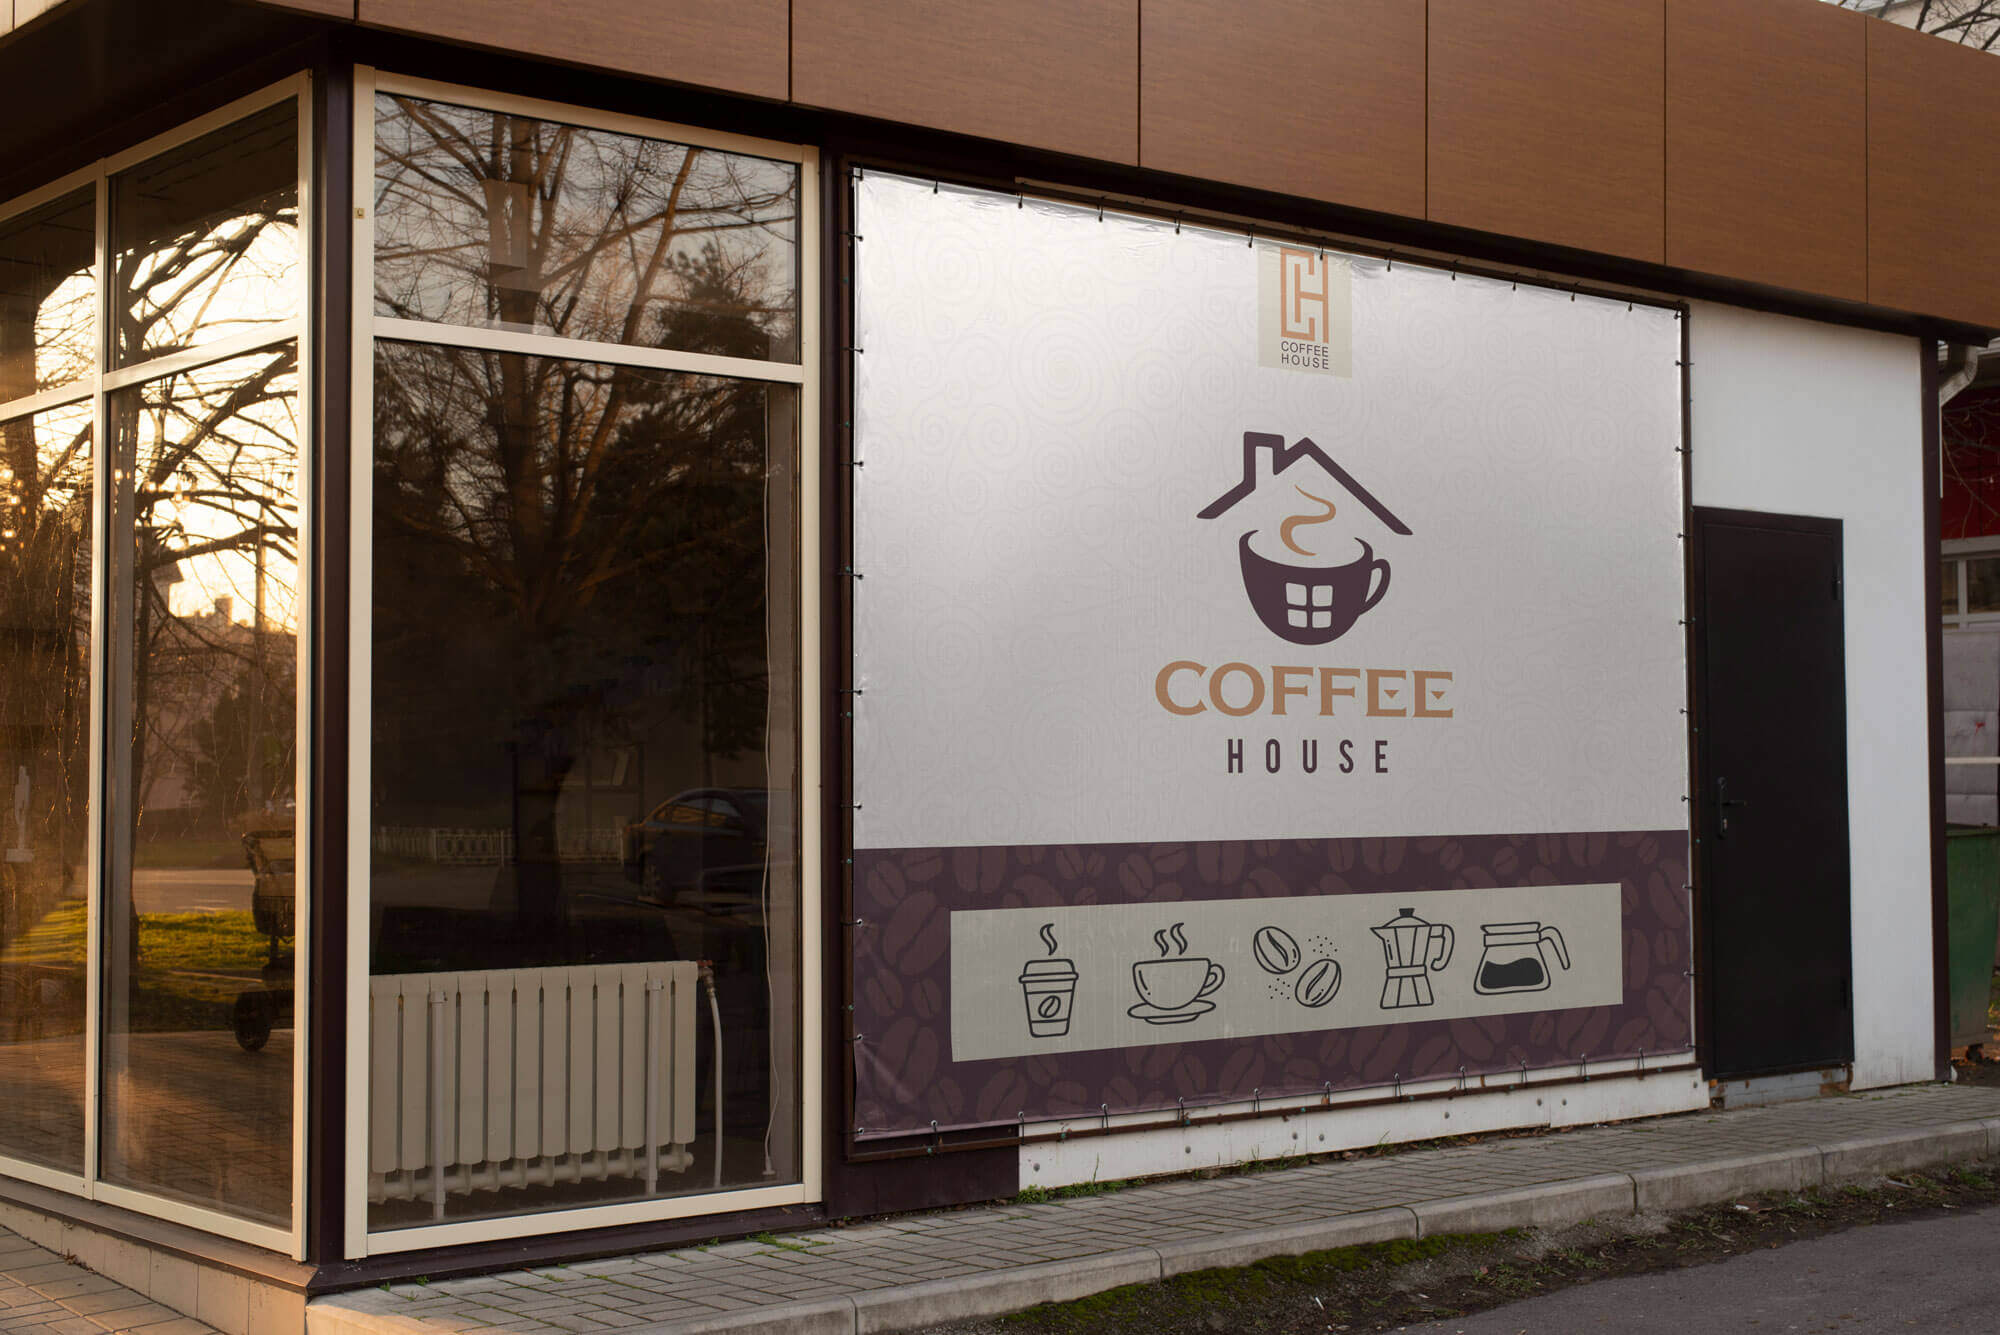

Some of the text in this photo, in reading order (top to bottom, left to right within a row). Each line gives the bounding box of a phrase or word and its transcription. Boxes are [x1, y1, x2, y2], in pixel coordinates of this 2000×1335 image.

[1281, 340, 1329, 358] COFFEE
[1281, 353, 1329, 370] HOUSE
[1155, 660, 1454, 718] COFFEE
[1227, 738, 1389, 774] HOUSE
